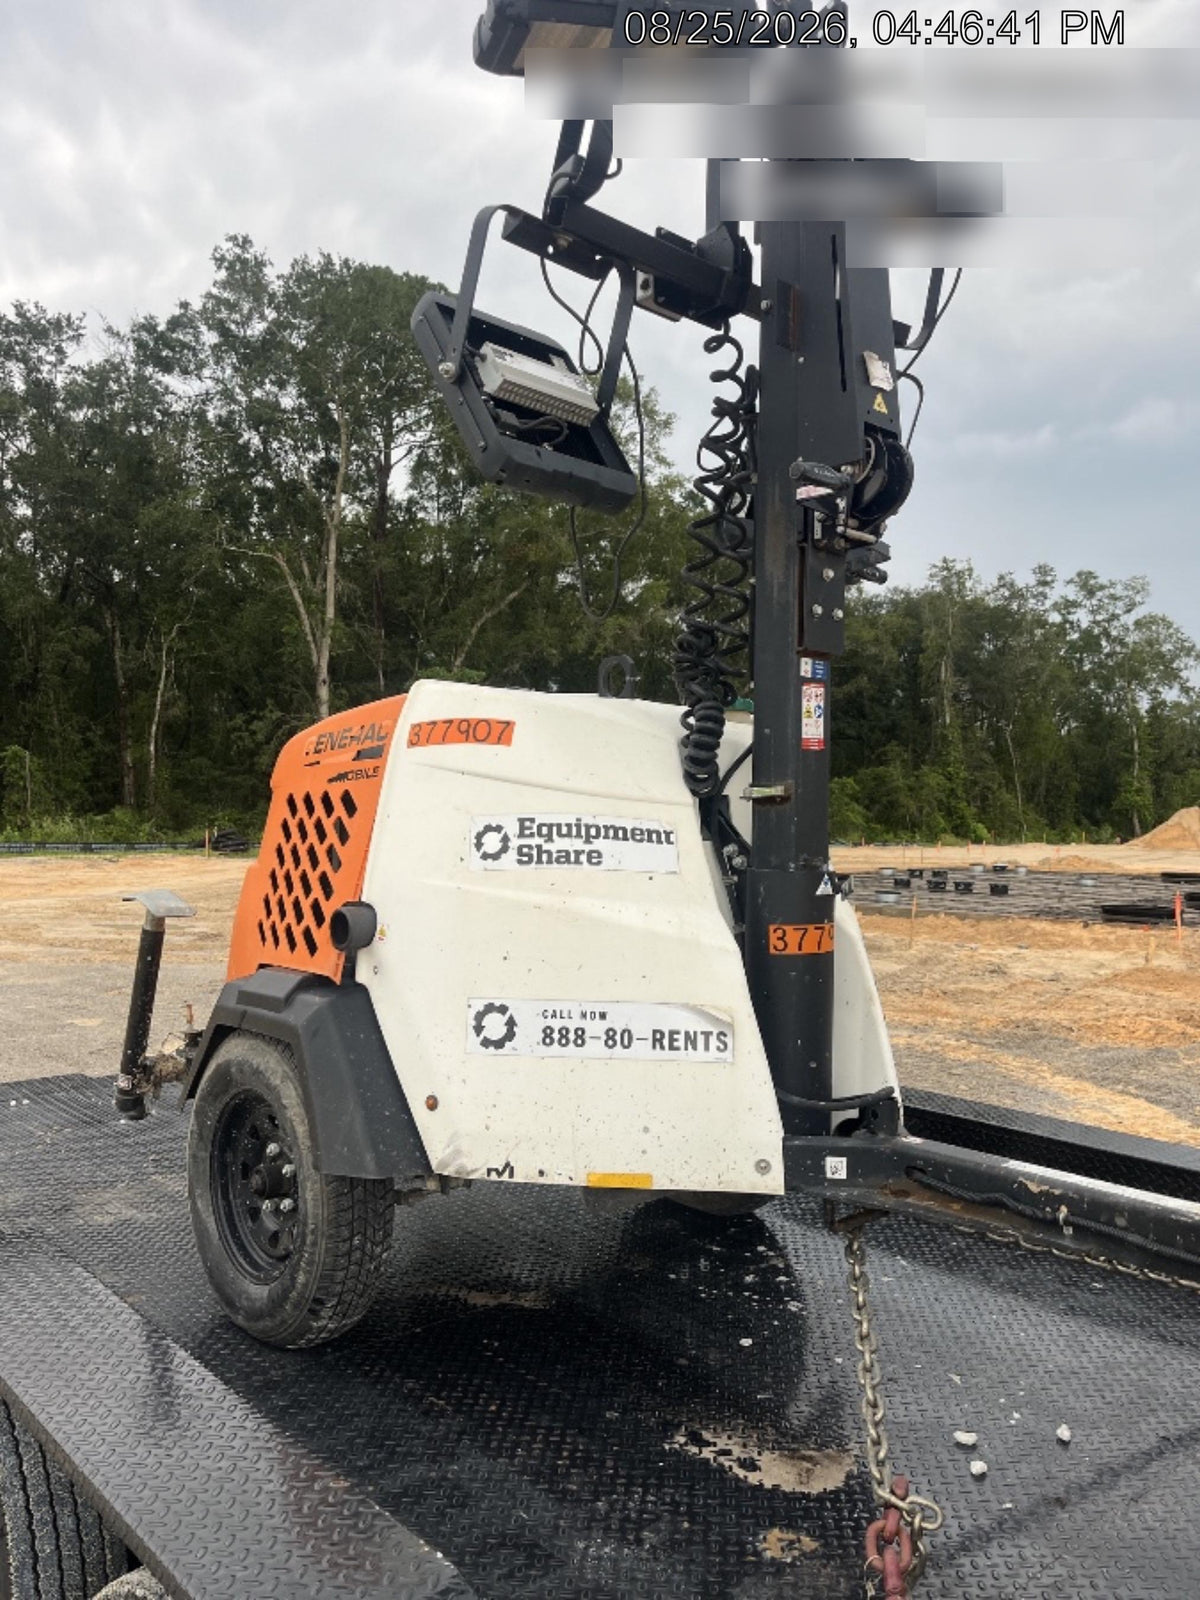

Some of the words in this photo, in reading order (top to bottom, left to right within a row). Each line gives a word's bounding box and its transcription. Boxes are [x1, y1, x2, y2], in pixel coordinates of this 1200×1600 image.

[409, 719, 511, 746] 377907
[516, 817, 675, 845] Equipment
[516, 843, 604, 866] Share
[541, 1008, 574, 1020] CALL
[580, 1010, 609, 1022] NOW
[540, 1025, 729, 1053] 888-80-RENTS
